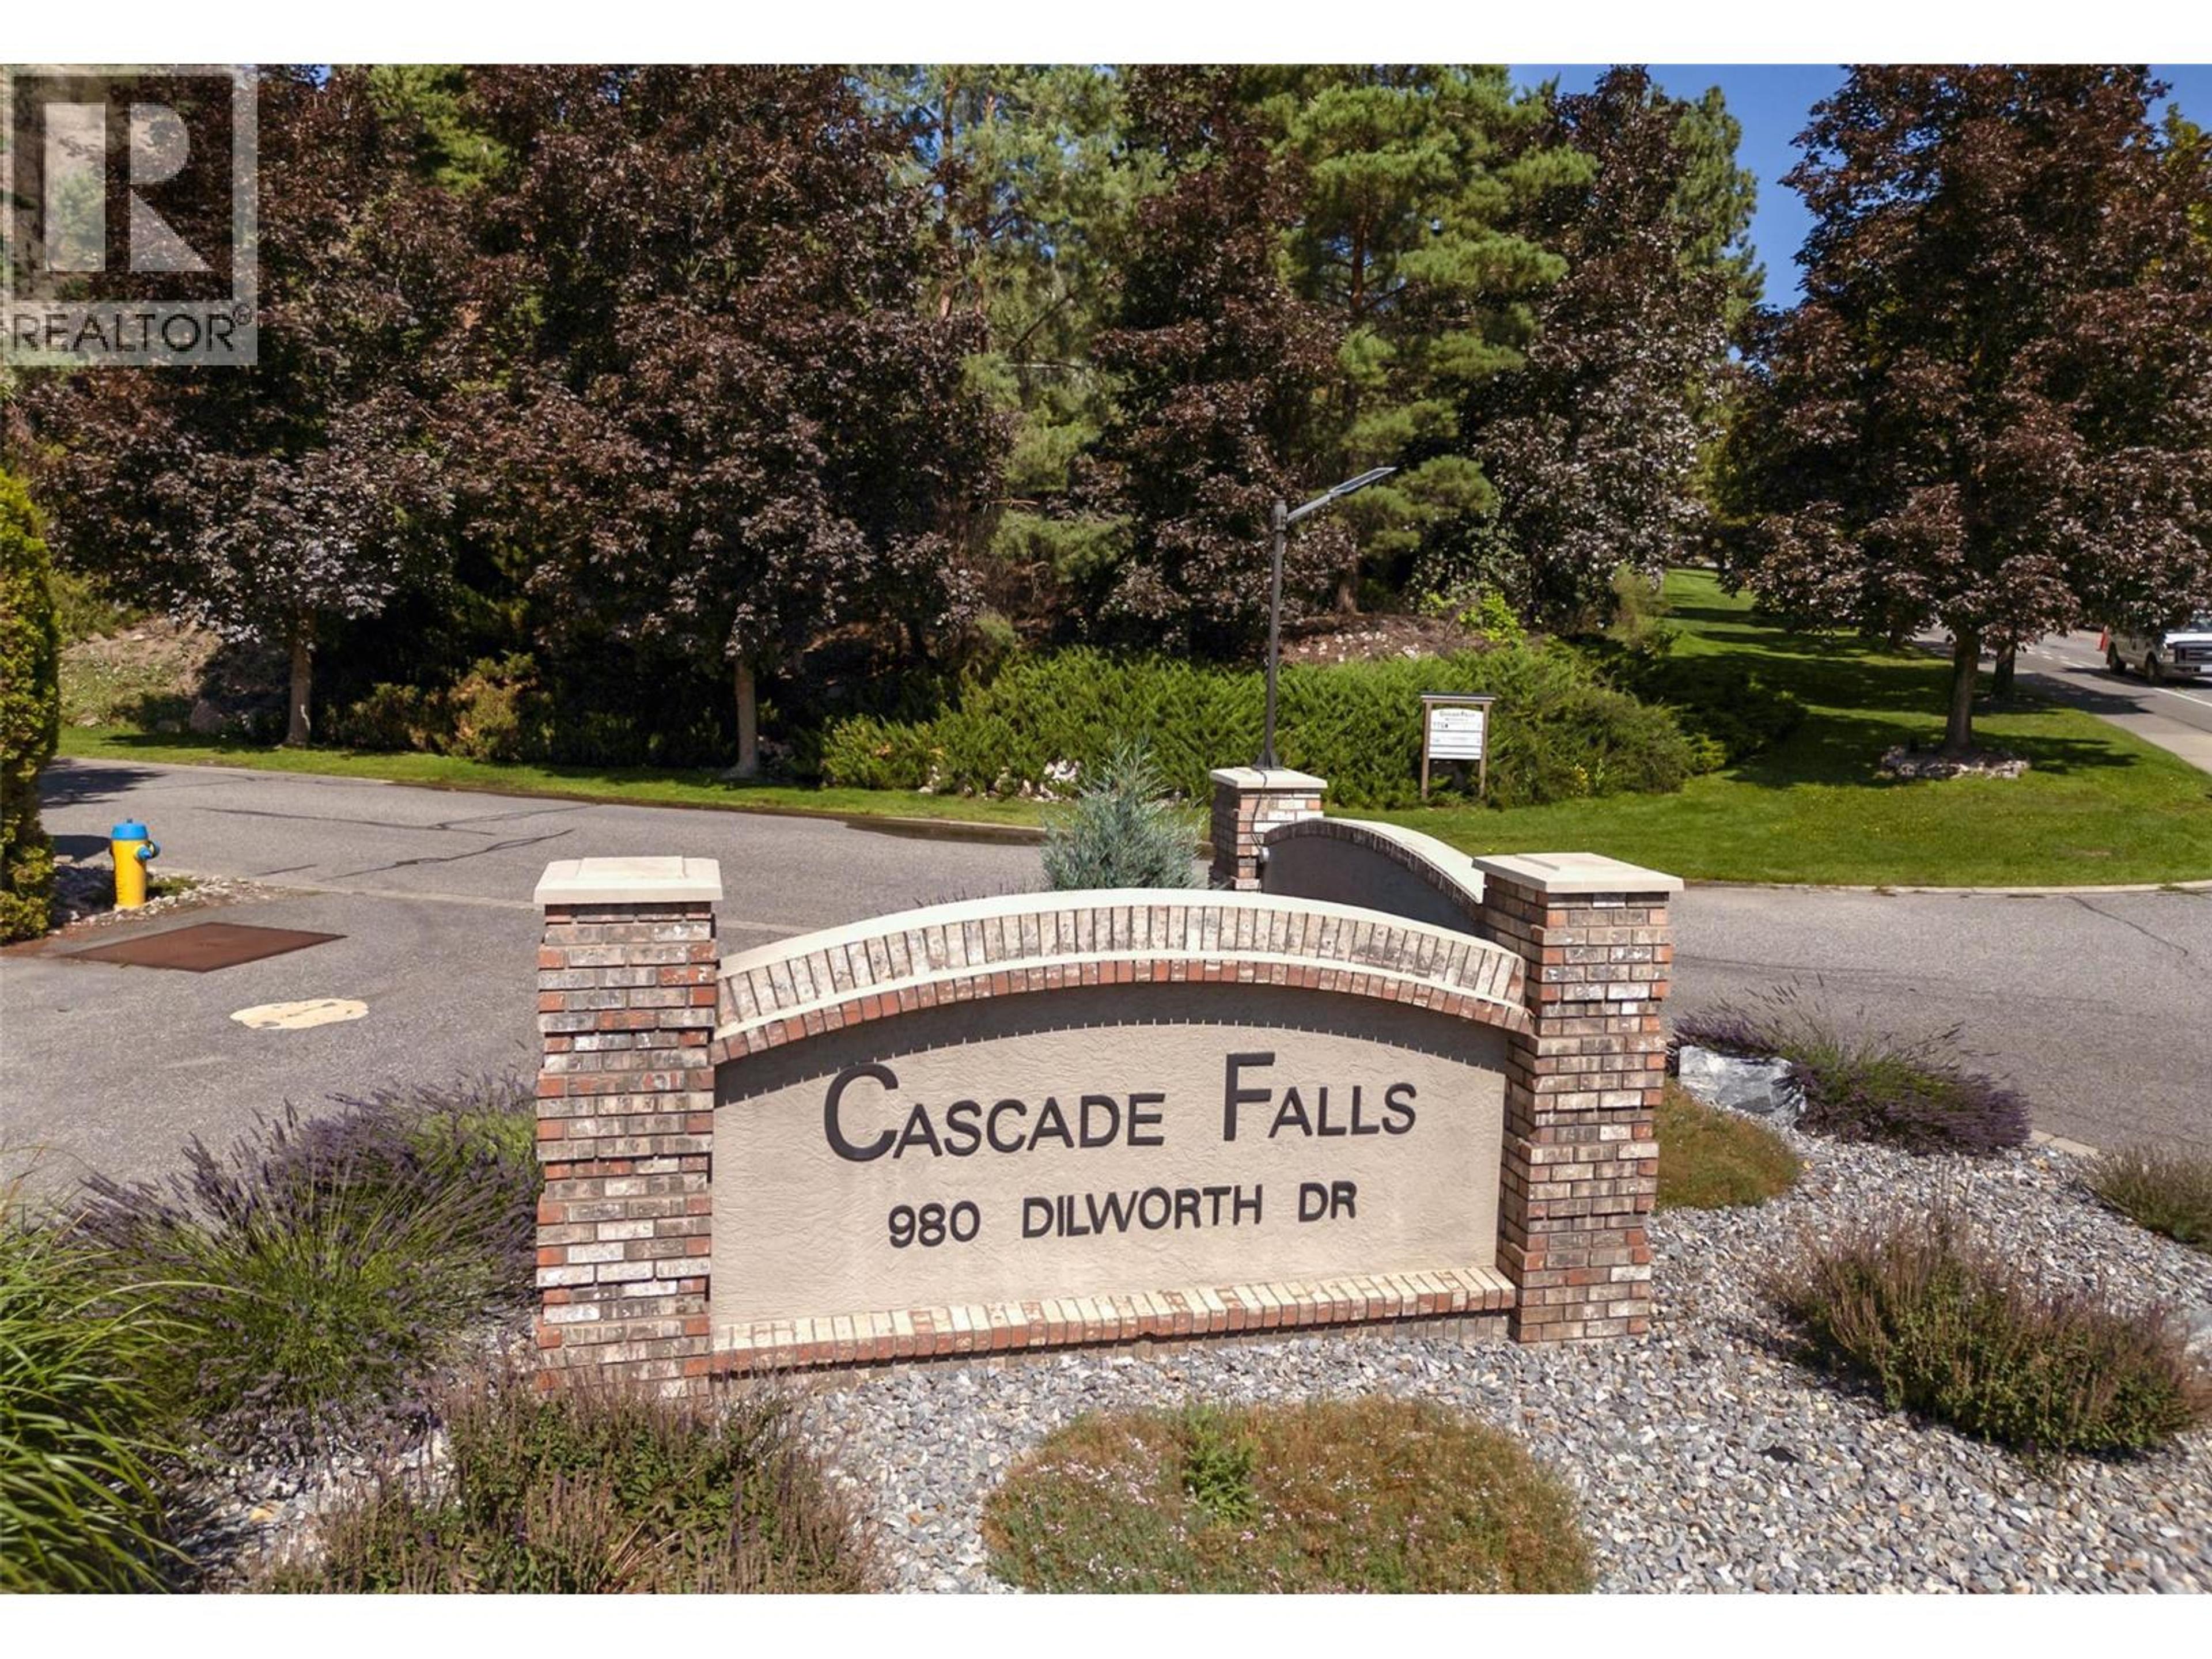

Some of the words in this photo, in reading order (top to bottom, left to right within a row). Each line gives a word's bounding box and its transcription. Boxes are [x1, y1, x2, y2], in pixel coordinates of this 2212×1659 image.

[823, 1062, 1166, 1162] CASCADE
[1223, 1052, 1417, 1142] FALLS
[888, 1200, 981, 1248] 980
[1022, 1184, 1263, 1238] DILWORTH
[1298, 1181, 1357, 1222] DR
